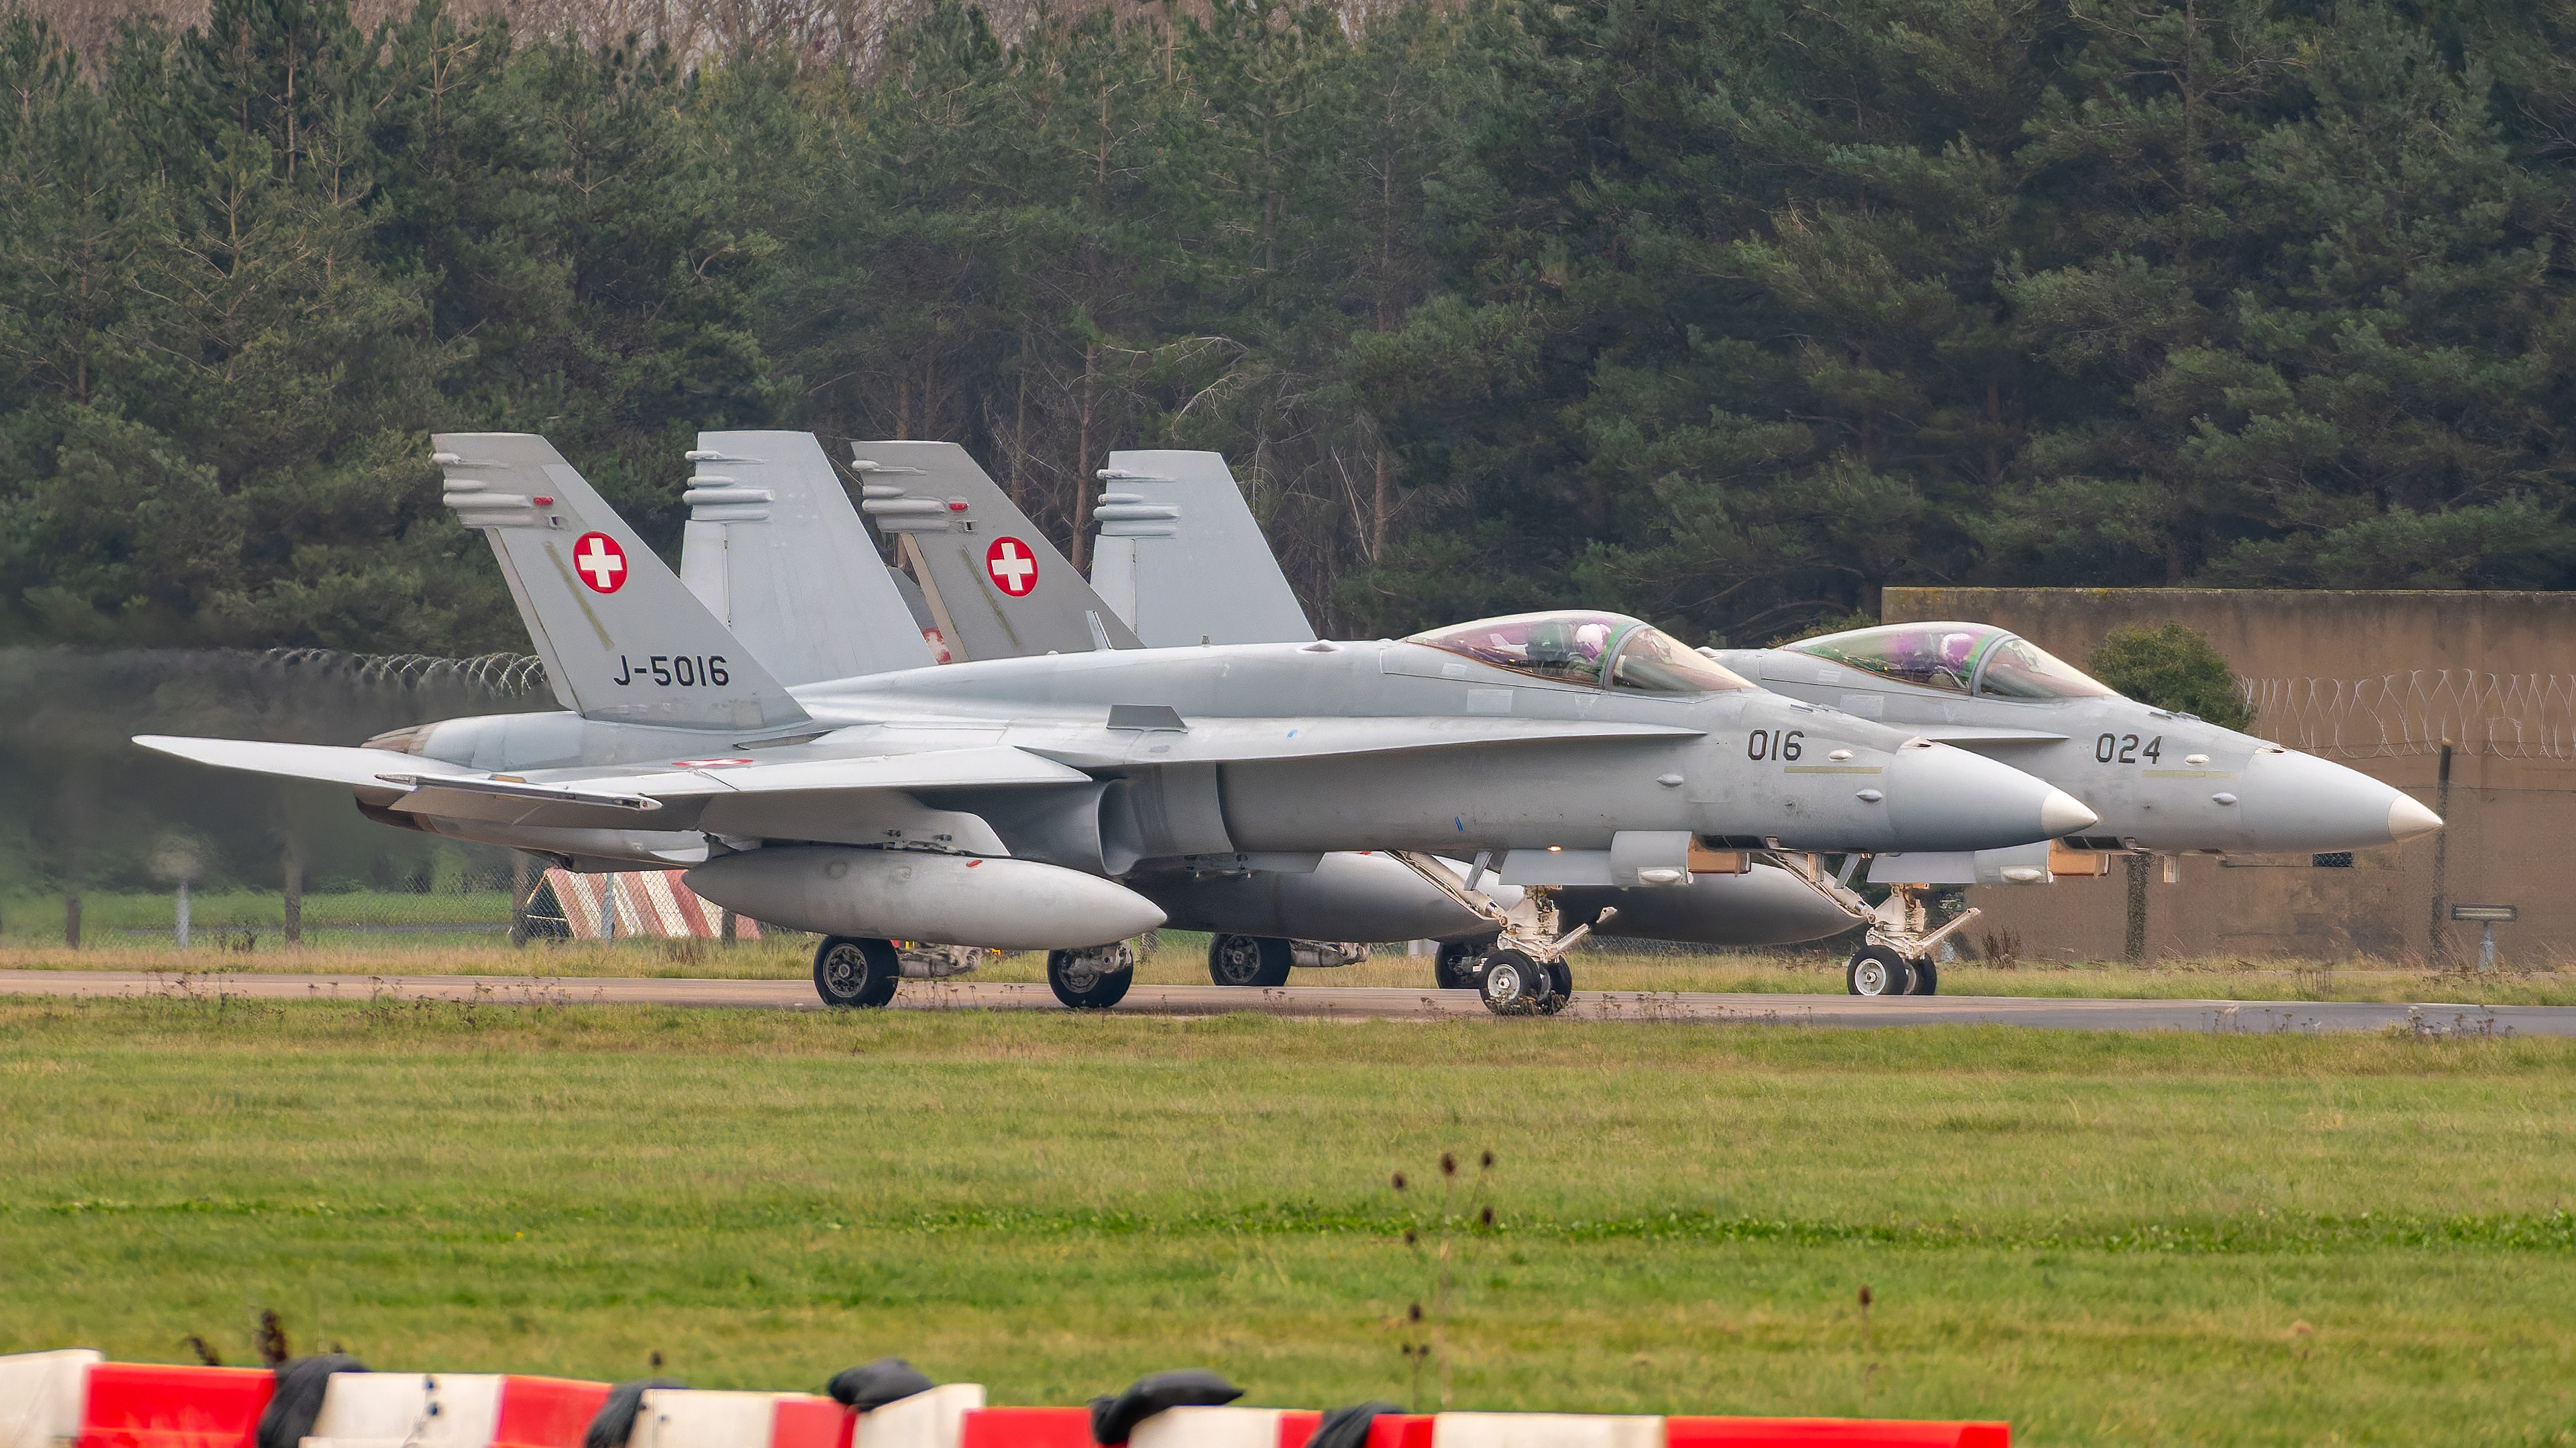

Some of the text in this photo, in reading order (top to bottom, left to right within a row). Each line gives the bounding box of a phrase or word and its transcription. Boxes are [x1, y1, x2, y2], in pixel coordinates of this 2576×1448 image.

[613, 655, 729, 687] J-5016
[1748, 730, 1805, 761] 016
[2095, 732, 2162, 765] 024
